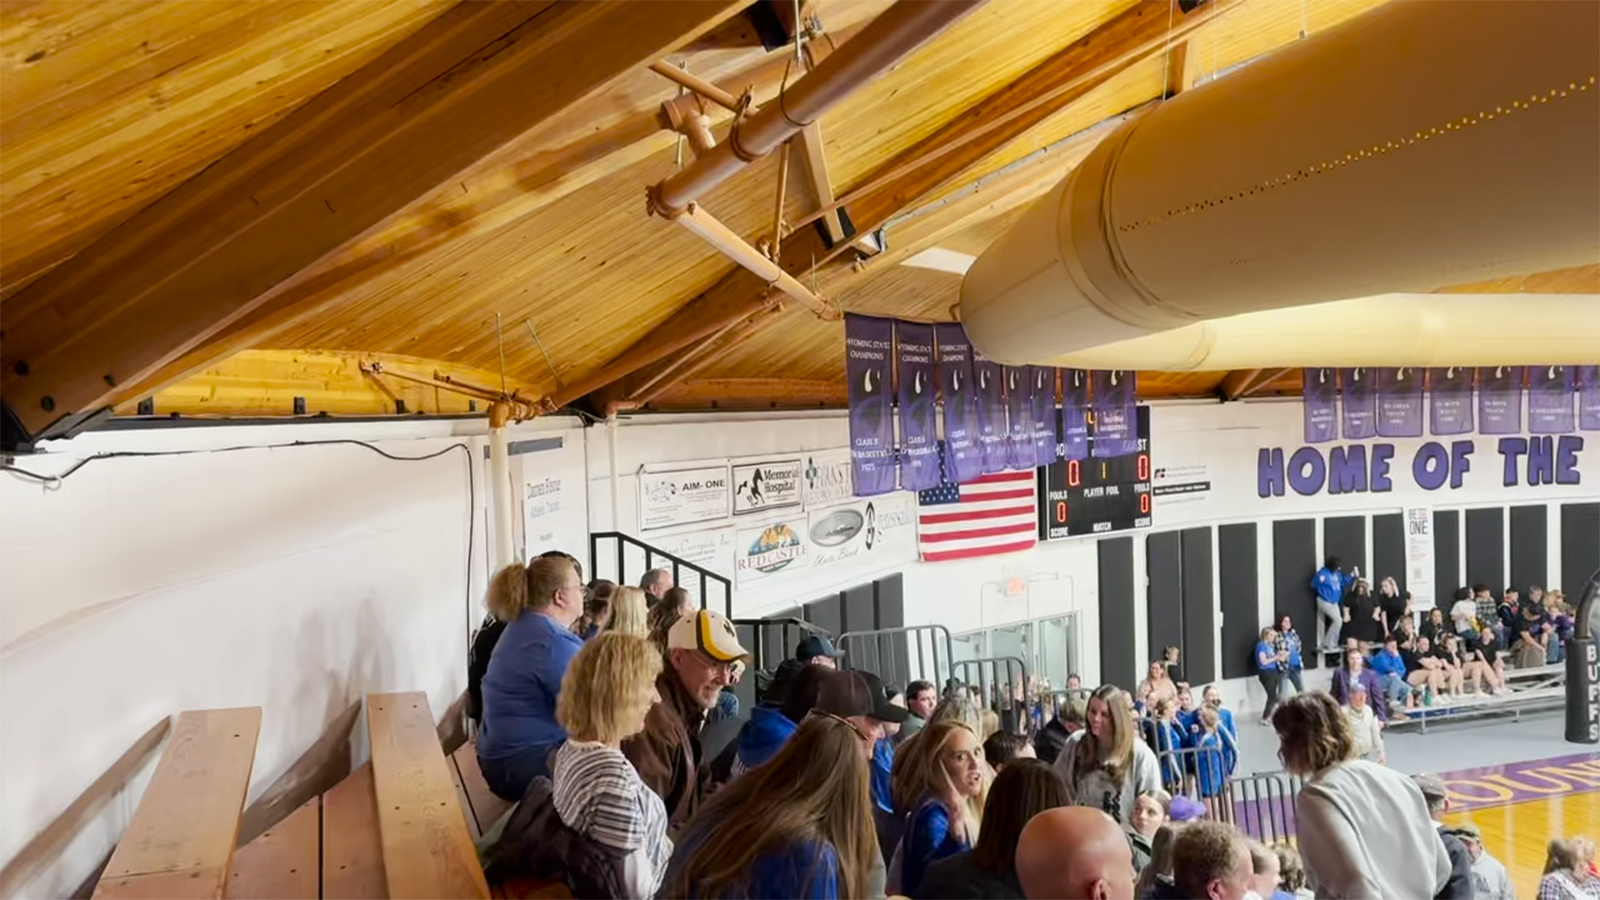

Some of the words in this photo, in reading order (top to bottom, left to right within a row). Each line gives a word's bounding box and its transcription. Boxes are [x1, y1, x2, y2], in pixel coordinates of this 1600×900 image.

[764, 465, 799, 480] Memorial
[1068, 459, 1080, 486] 0
[1138, 455, 1149, 480] 0
[1257, 443, 1395, 498] HOME
[1412, 440, 1475, 491] OF
[1497, 435, 1584, 487] THE
[764, 479, 796, 494] Hospital
[1084, 487, 1104, 497] PLAYER
[1106, 485, 1119, 495] FOUL
[1134, 483, 1150, 493] FOULS
[1050, 490, 1068, 500] FOULS
[1140, 494, 1149, 513] 0
[1057, 502, 1066, 523] 0
[1051, 527, 1068, 537] SCORE
[1409, 520, 1429, 535] ONE
[1586, 644, 1599, 741] BUFFS
